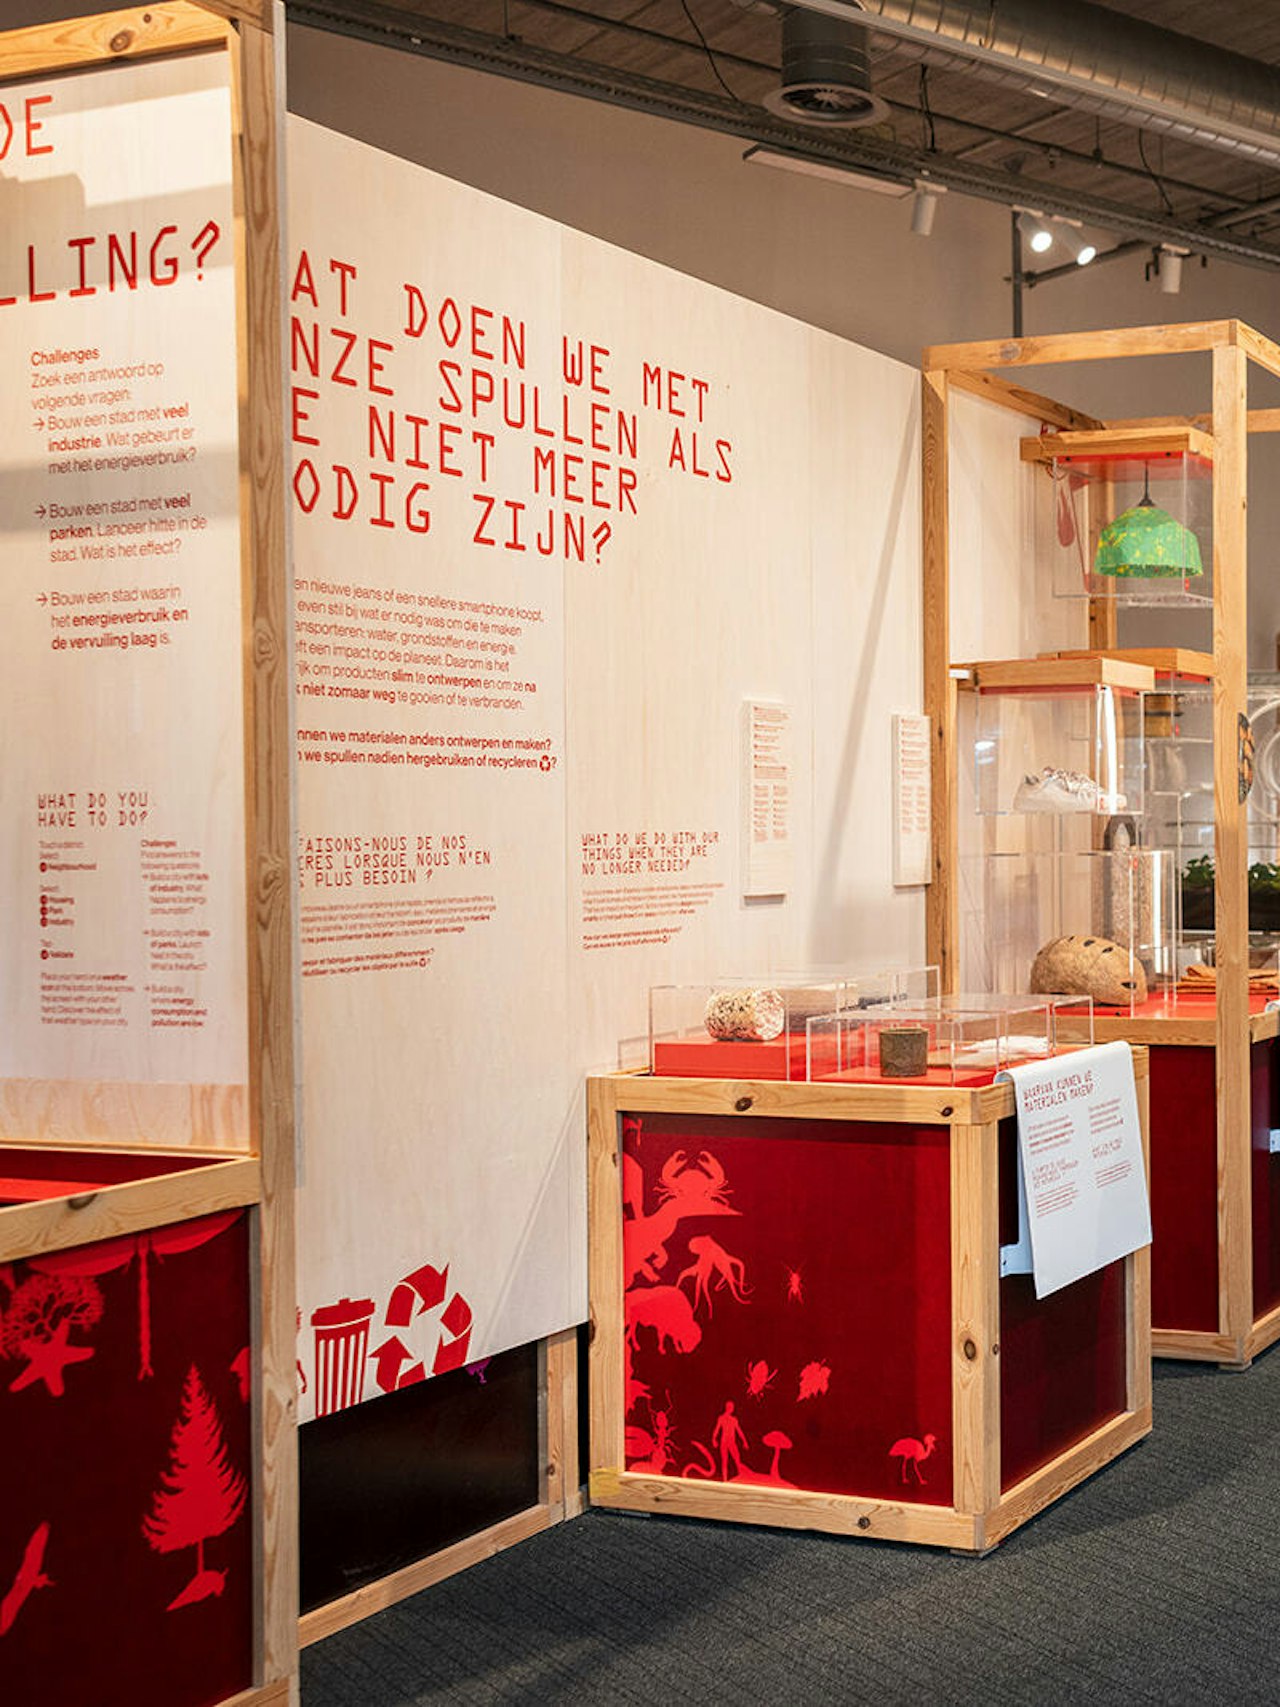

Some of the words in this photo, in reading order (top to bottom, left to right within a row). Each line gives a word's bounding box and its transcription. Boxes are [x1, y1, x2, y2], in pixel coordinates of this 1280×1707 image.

[31, 348, 100, 366] Challenges
[403, 284, 526, 370] DOEN
[563, 334, 610, 395] WE
[643, 362, 709, 423] MET
[31, 373, 60, 388] Zoek
[64, 372, 86, 384] een
[88, 365, 145, 382] antwoord
[147, 363, 164, 377] op
[31, 393, 85, 411] volgende
[292, 316, 394, 396] NZE
[438, 360, 638, 459] SPULLEN
[668, 427, 732, 483] ALS
[48, 415, 81, 431] Bouw
[84, 414, 106, 426] een
[109, 410, 135, 425] stad
[137, 408, 160, 420] met
[163, 402, 189, 418] veel
[106, 433, 129, 446] Wat
[132, 428, 180, 447] gebeurt
[48, 460, 72, 474] met
[73, 458, 93, 472] het
[94, 446, 197, 470] energieverbruik?
[369, 405, 495, 482] NIET
[534, 446, 638, 515] MEER
[49, 503, 83, 518] Bouw
[86, 502, 108, 515] een
[110, 499, 136, 513] stad
[139, 497, 162, 510] met
[164, 493, 191, 509] veel
[293, 459, 431, 533] ODIG
[473, 494, 611, 564] ZIJN?
[97, 522, 148, 537] Lanceer
[191, 515, 207, 529] de
[80, 546, 103, 559] Wat
[118, 545, 137, 557] het
[139, 538, 181, 556] effect?
[51, 591, 85, 606] Bouw
[88, 590, 109, 604] een
[112, 588, 138, 602] stad
[140, 587, 180, 600] waarin
[72, 608, 169, 628] energieverbruik
[172, 610, 188, 621] en
[51, 635, 67, 649] de
[69, 633, 128, 649] vervuiling
[131, 632, 157, 647] laag
[392, 669, 413, 682] slim
[427, 673, 482, 689] ontwerpen
[524, 683, 537, 693] na
[303, 681, 325, 696] niet
[328, 686, 370, 699] zomaar
[372, 690, 396, 704] weg
[330, 731, 346, 742] we
[349, 730, 406, 744] materialen
[410, 732, 445, 747] anders
[447, 736, 500, 750] ontwerpen
[502, 740, 514, 749] en
[515, 738, 551, 751] maken?
[304, 751, 321, 762] we
[324, 749, 365, 764] spullen
[368, 750, 404, 764] nadien
[406, 751, 474, 768] hergebruiken
[476, 755, 486, 767] of
[488, 756, 537, 770] recycleren
[38, 793, 75, 809] WHAT
[88, 793, 106, 808] DO
[118, 792, 148, 807] YOU
[38, 811, 75, 827] HAVE
[88, 811, 107, 826] TO
[119, 810, 148, 826] DO?
[418, 836, 432, 850] DE
[442, 835, 466, 849] NOS
[582, 833, 608, 847] WHAT
[616, 833, 628, 845] DO
[635, 832, 647, 845] WE
[655, 832, 666, 845] DO
[672, 831, 696, 844] WITH
[345, 853, 406, 869] LORSQUE
[418, 852, 449, 866] NOUS
[582, 847, 621, 860] THINGS
[629, 846, 653, 859] WHEN
[660, 846, 683, 858] THEY
[691, 845, 707, 857] ARE
[582, 861, 595, 875] NO
[603, 860, 641, 875] LONGER
[315, 872, 352, 887] PLUS
[363, 869, 416, 884] BESOIN
